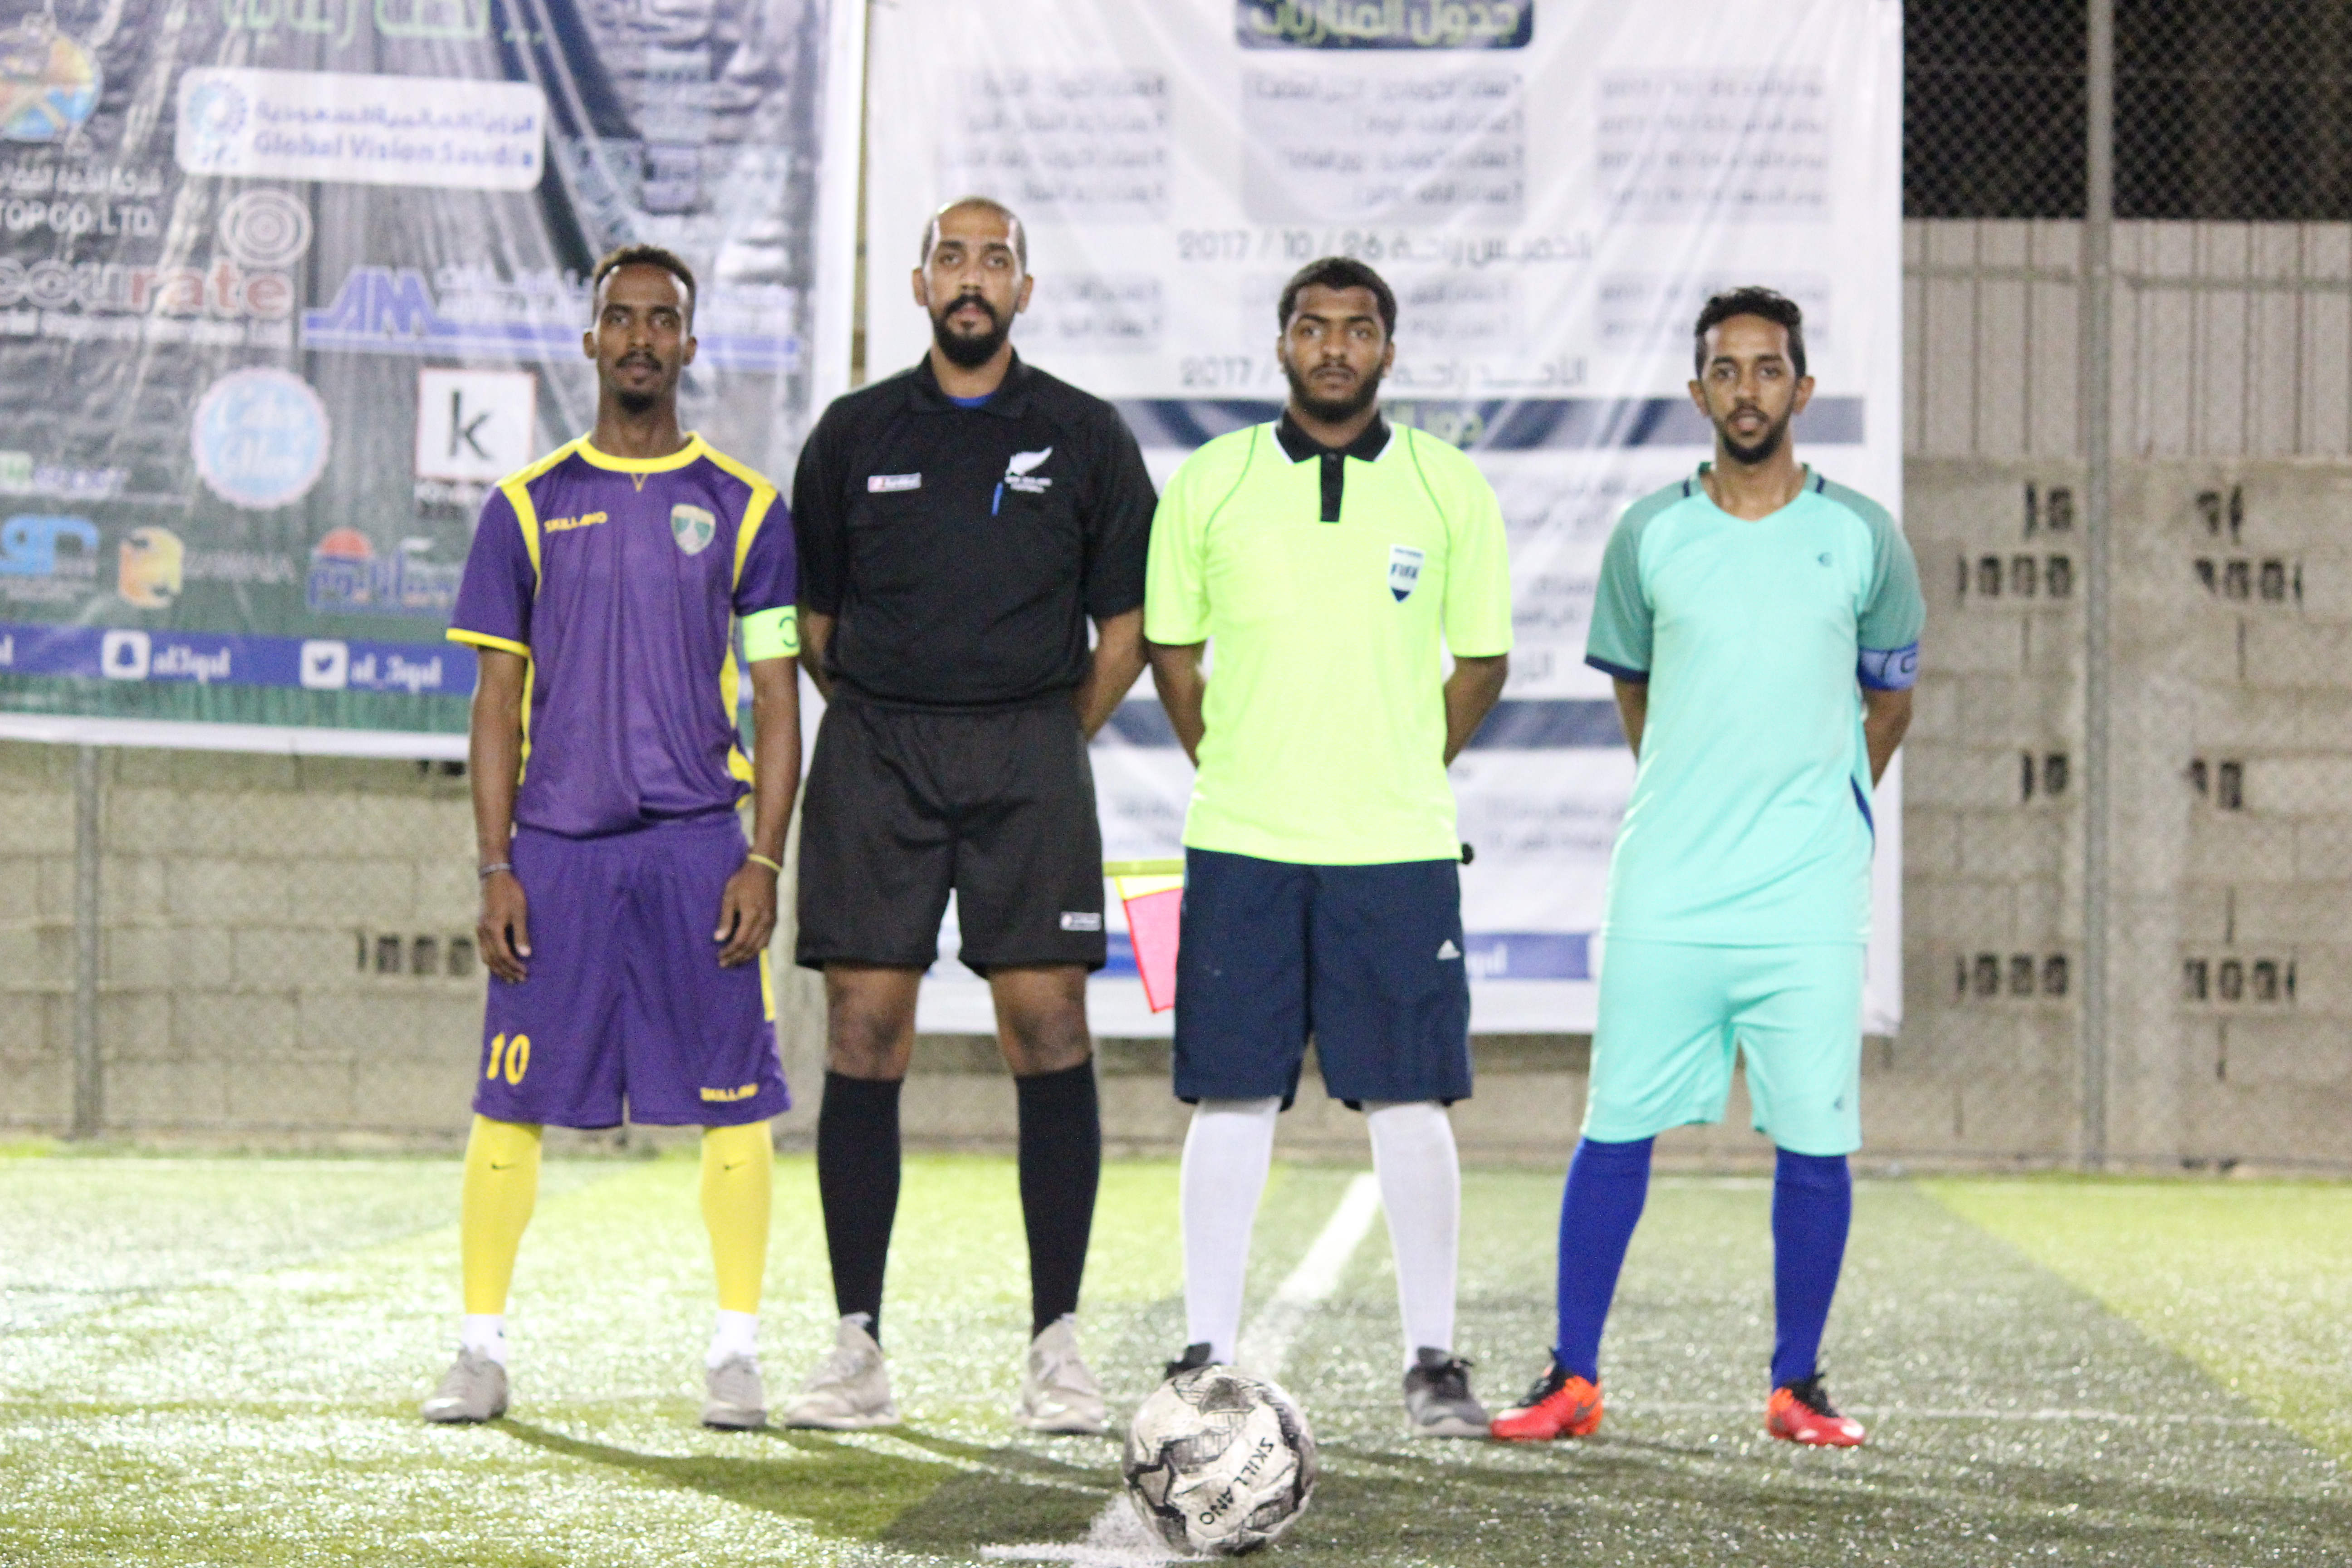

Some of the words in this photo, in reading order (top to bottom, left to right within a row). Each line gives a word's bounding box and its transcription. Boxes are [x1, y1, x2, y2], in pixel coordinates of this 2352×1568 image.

[254, 129, 343, 160] Global
[348, 133, 435, 164] Vision
[486, 1033, 530, 1085] 10
